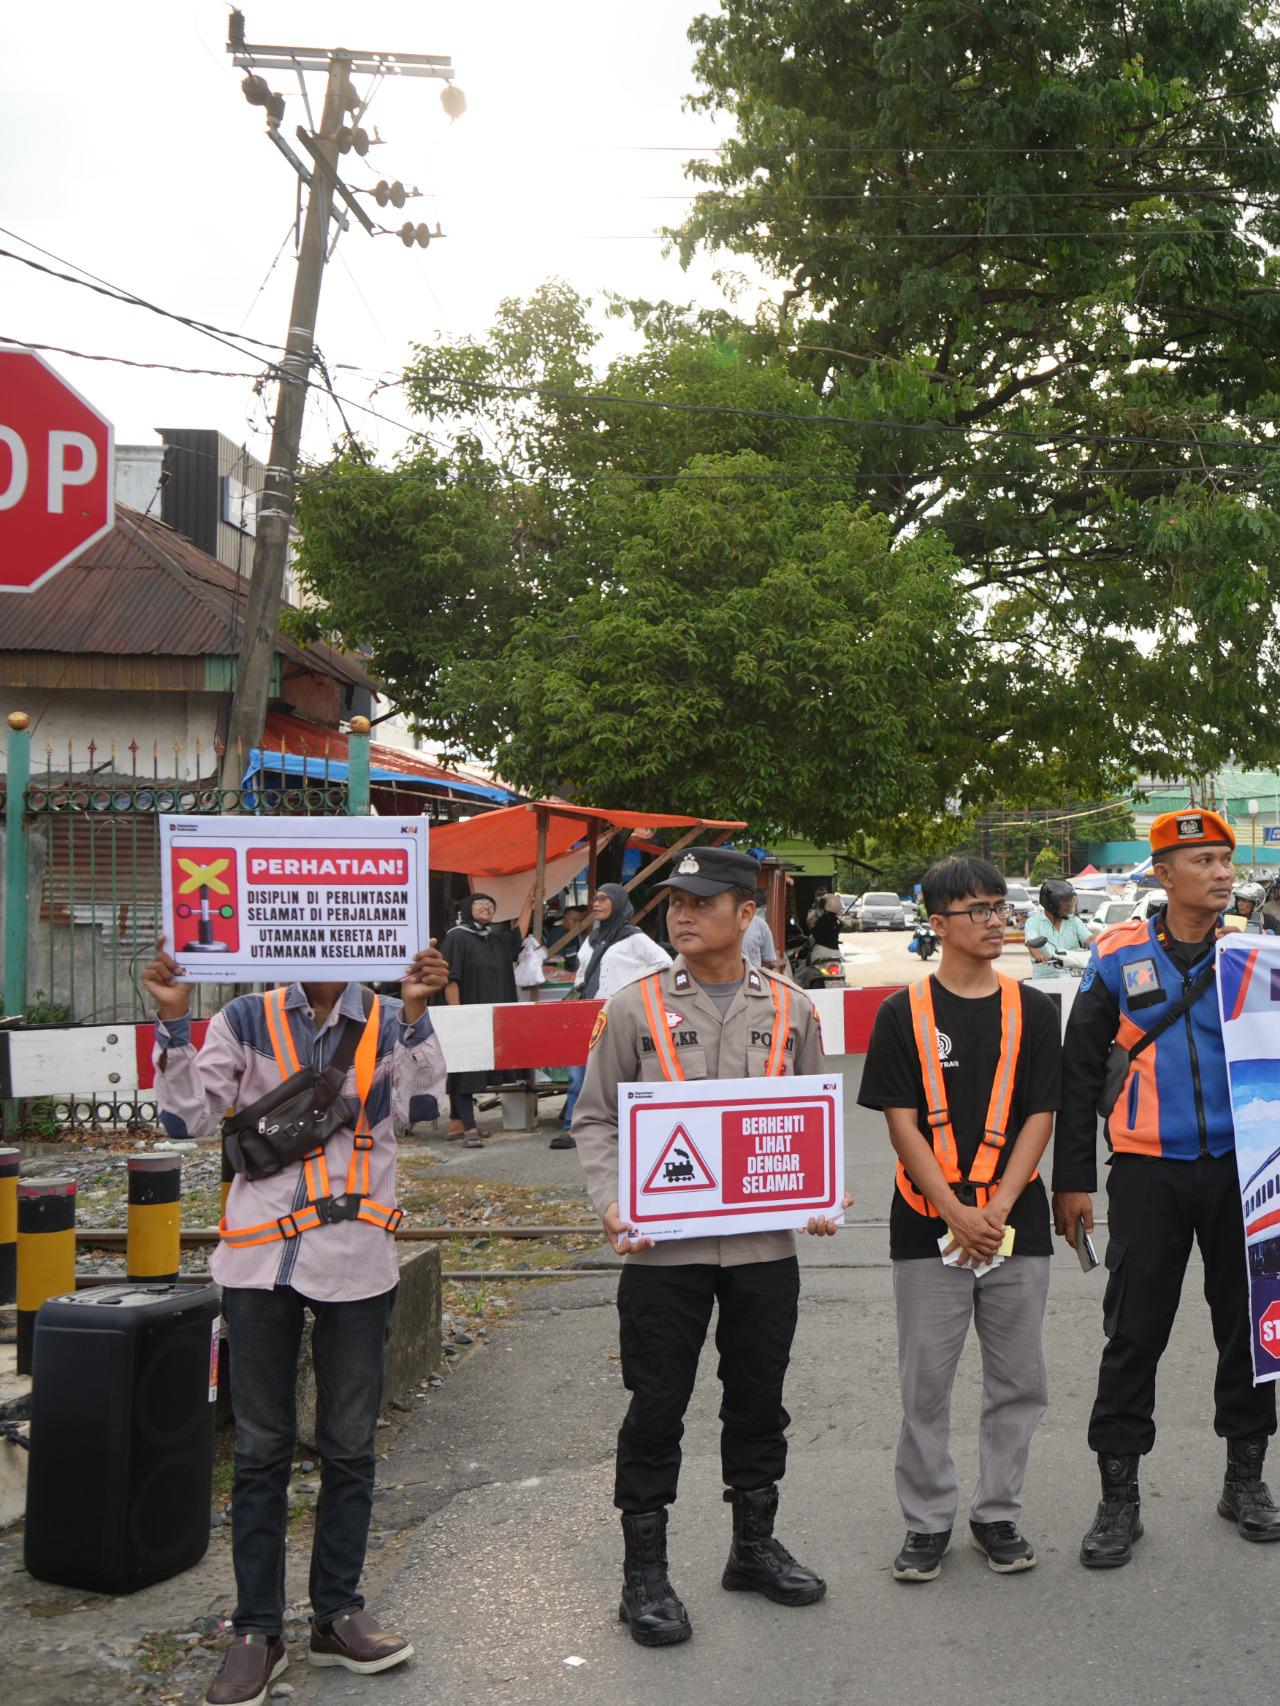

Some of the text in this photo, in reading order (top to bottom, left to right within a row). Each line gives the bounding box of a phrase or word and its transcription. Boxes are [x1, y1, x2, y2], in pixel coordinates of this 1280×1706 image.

[251, 858, 404, 875] PERHATIAN!
[247, 890, 408, 905] DISIPLIN DI PERLINTASAN
[248, 907, 406, 921] SELAMAT DI PERJALANAN
[260, 929, 397, 942] UTAMAKAN KERETA API
[250, 945, 407, 958] UTAMAKAN KESELAMATAN
[742, 1115, 805, 1136] BERHENTI
[755, 1135, 791, 1154] LIHAT
[747, 1154, 800, 1174] DENGAR
[742, 1173, 805, 1194] SELAMAT
